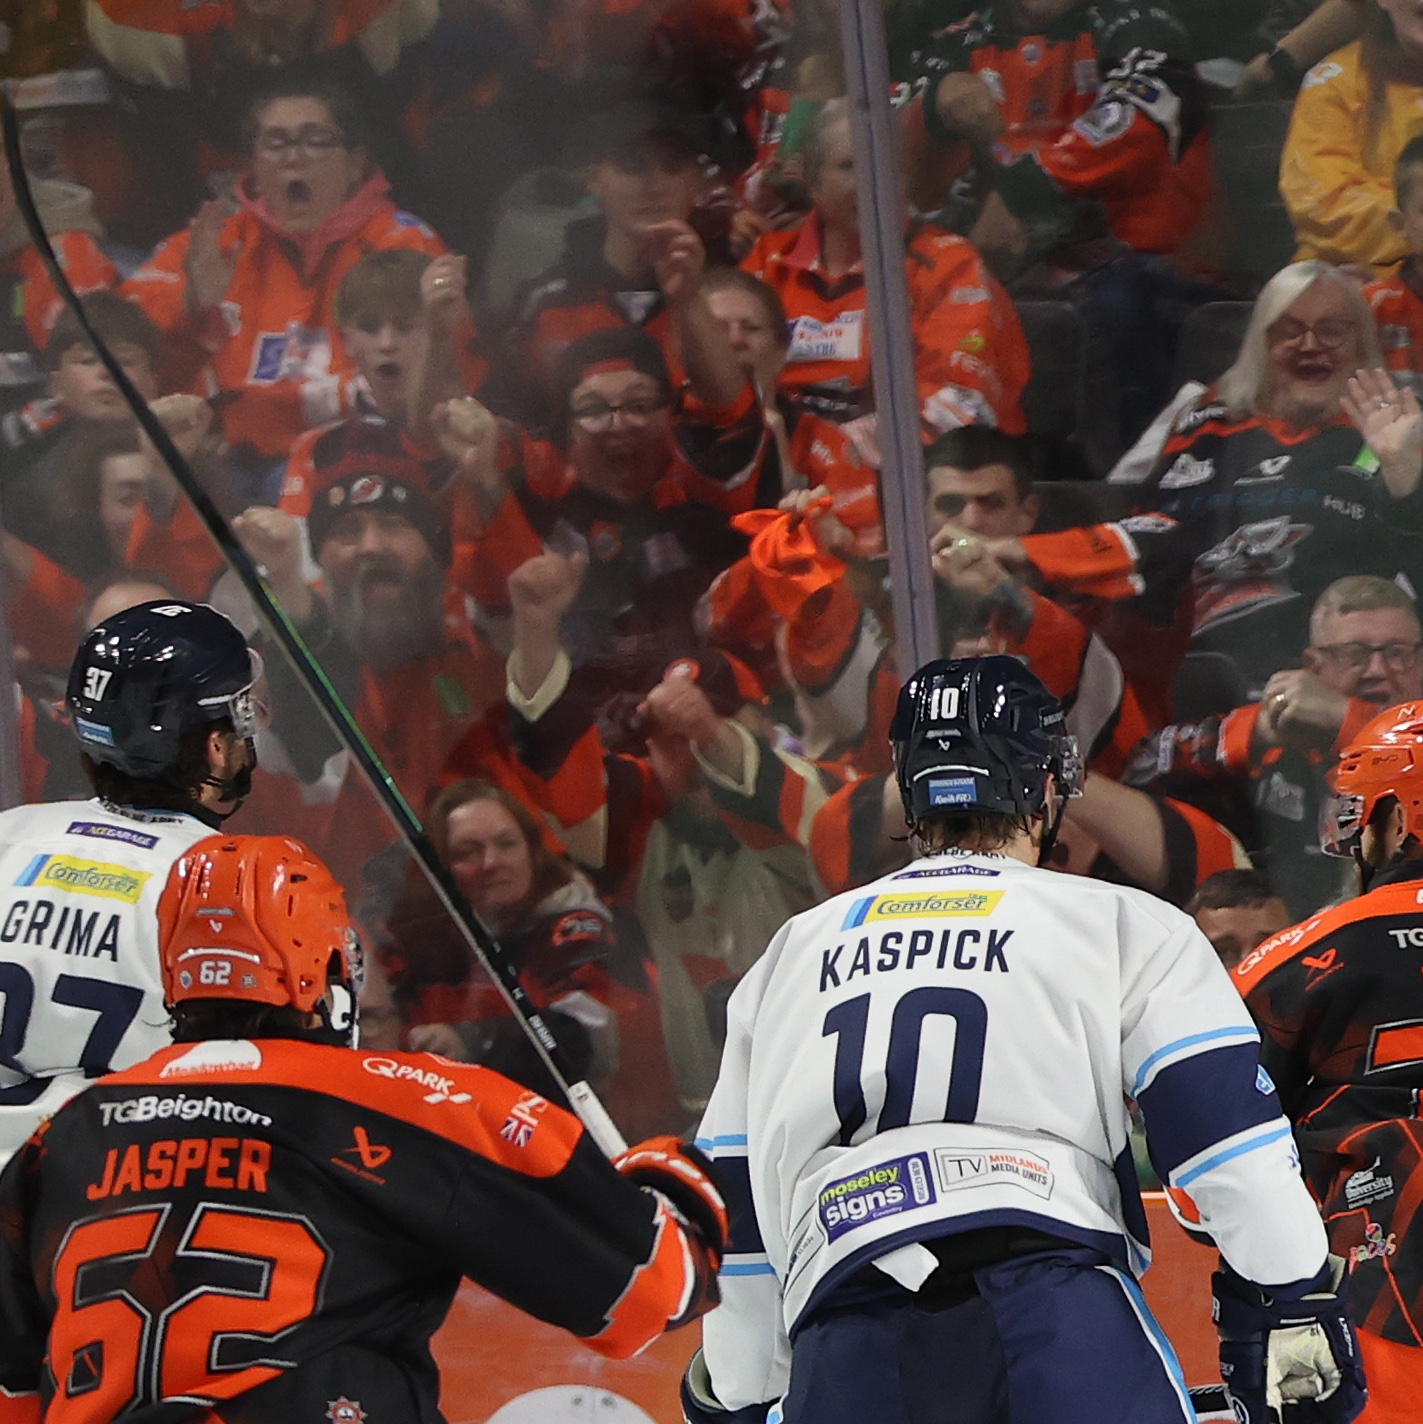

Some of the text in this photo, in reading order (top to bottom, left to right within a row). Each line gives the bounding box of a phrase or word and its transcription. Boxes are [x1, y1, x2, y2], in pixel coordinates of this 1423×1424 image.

[84, 667, 112, 701] 37
[930, 687, 959, 720] 10
[0, 899, 121, 962] GRIMA
[200, 960, 232, 985] 62
[819, 929, 1015, 992] KASPICK
[822, 986, 988, 1147] 10
[100, 1094, 273, 1128] TGBeighton
[86, 1137, 272, 1201] JASPER
[822, 1165, 900, 1204] moseley
[948, 1158, 984, 1178] TV
[990, 1163, 1048, 1186] MEDIA UNITS
[826, 1184, 906, 1227] signs
